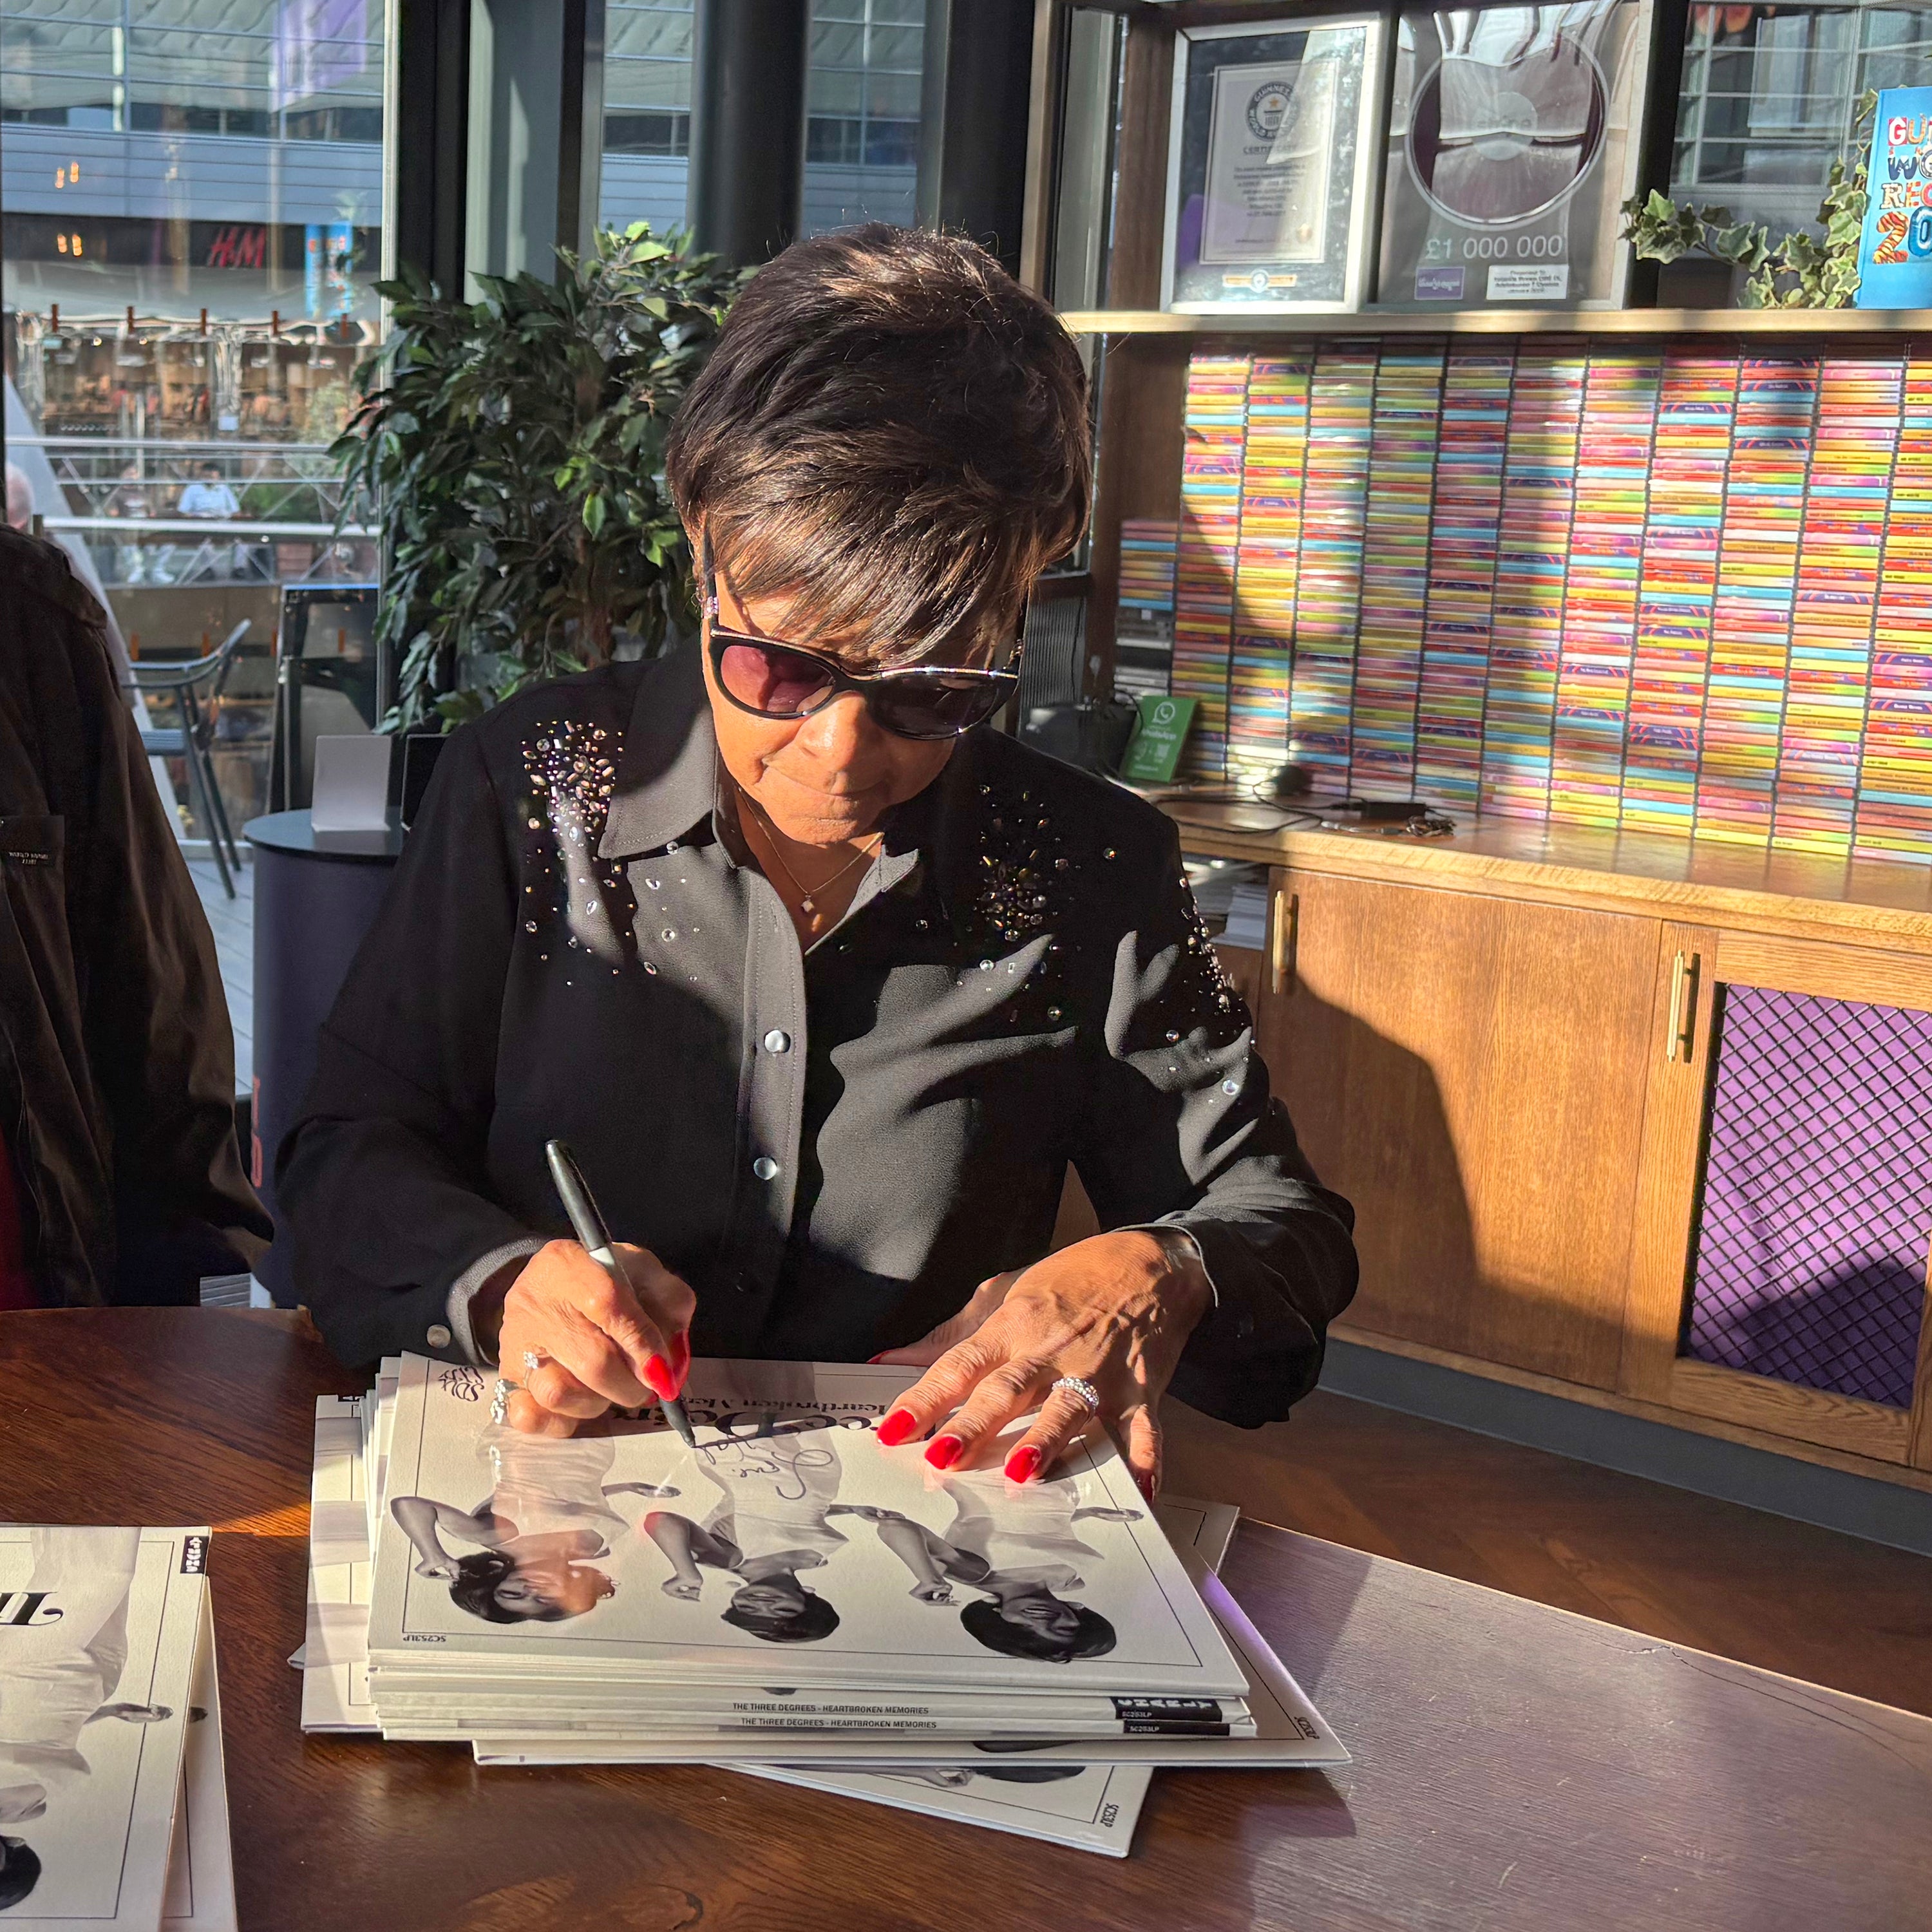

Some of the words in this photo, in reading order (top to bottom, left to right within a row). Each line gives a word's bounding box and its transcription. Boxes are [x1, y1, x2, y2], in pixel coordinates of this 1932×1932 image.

[1426, 238, 1452, 260] £1
[1463, 236, 1508, 259] 000
[1517, 235, 1562, 258] 000
[750, 1703, 776, 1711] THREE
[778, 1703, 816, 1712] DEGREES
[822, 1705, 883, 1713] HEARTBROKEN
[885, 1706, 929, 1714] MEMORIES
[759, 1718, 785, 1726] THREE
